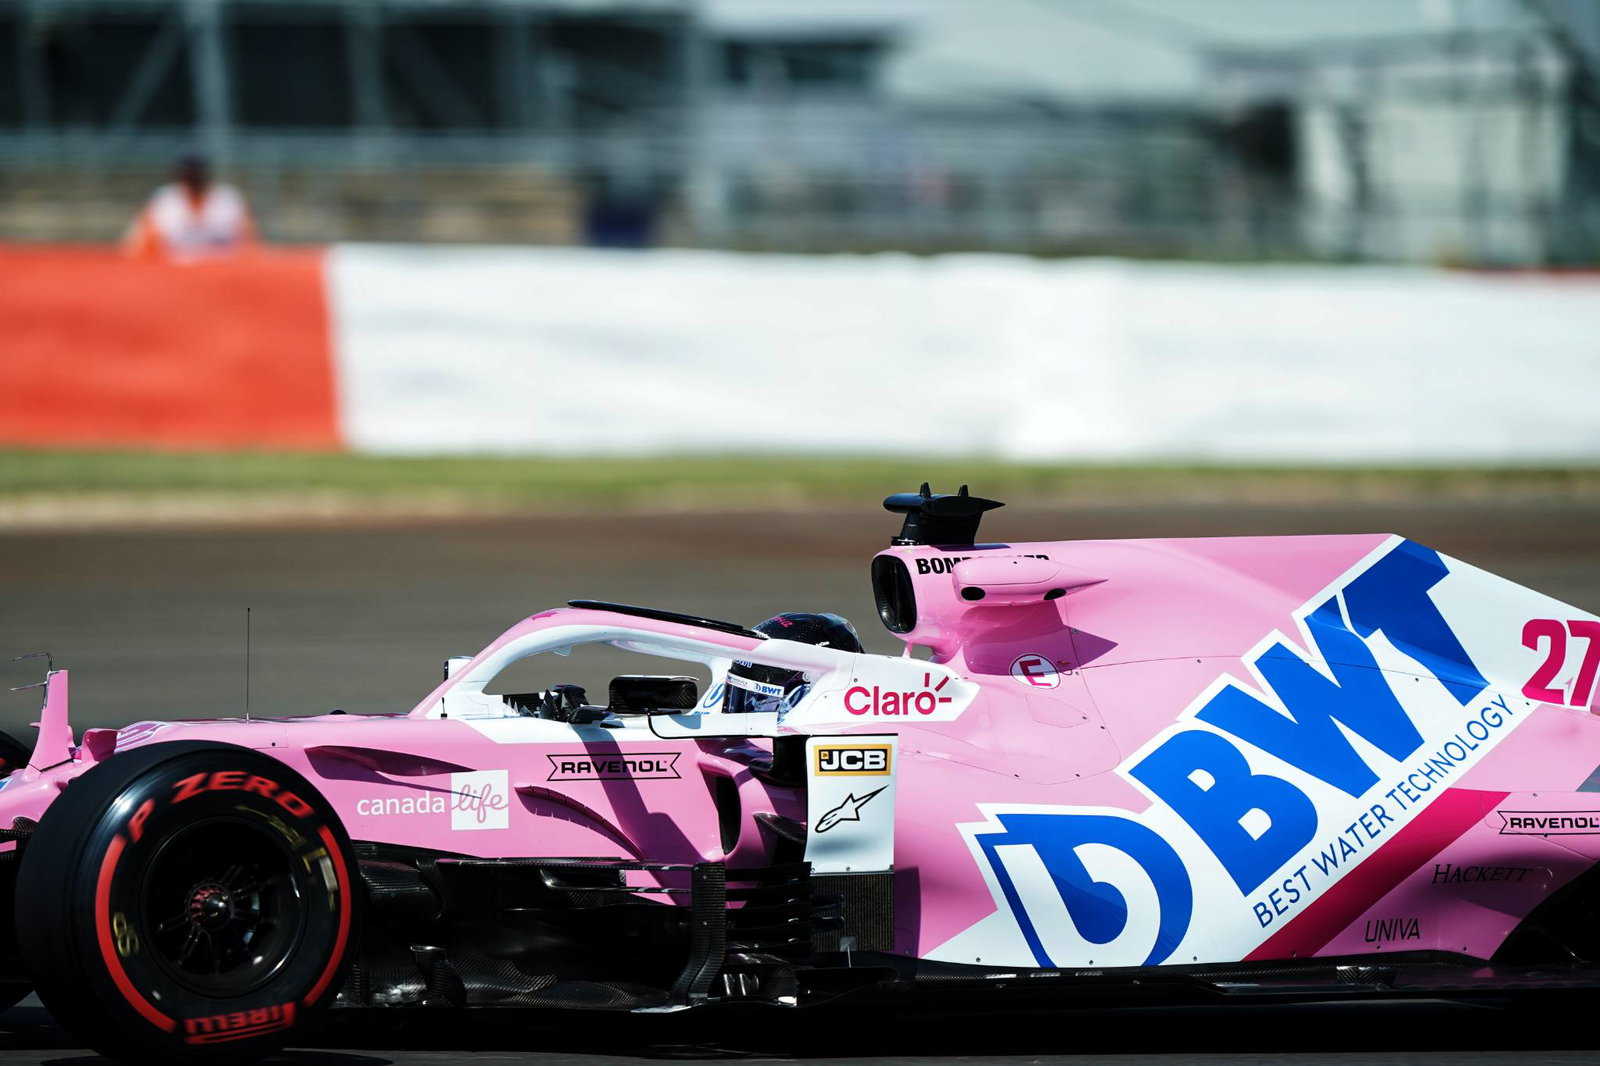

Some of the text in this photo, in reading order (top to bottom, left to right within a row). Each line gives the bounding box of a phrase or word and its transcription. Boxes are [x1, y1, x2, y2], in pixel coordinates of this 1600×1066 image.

[1018, 659, 1052, 687] E
[1521, 618, 1600, 707] 27
[761, 686, 781, 695] BWT
[844, 684, 938, 716] Claro
[1126, 538, 1490, 897] BWT
[561, 760, 668, 774] RAVENOL
[820, 750, 886, 771] JCB
[171, 770, 316, 819] ZERO
[357, 783, 509, 824] canada life
[1252, 694, 1513, 928] BEST WATER TECHNOLOGY
[1509, 817, 1600, 829] RAVENOL
[1365, 917, 1420, 943] UNIVA
